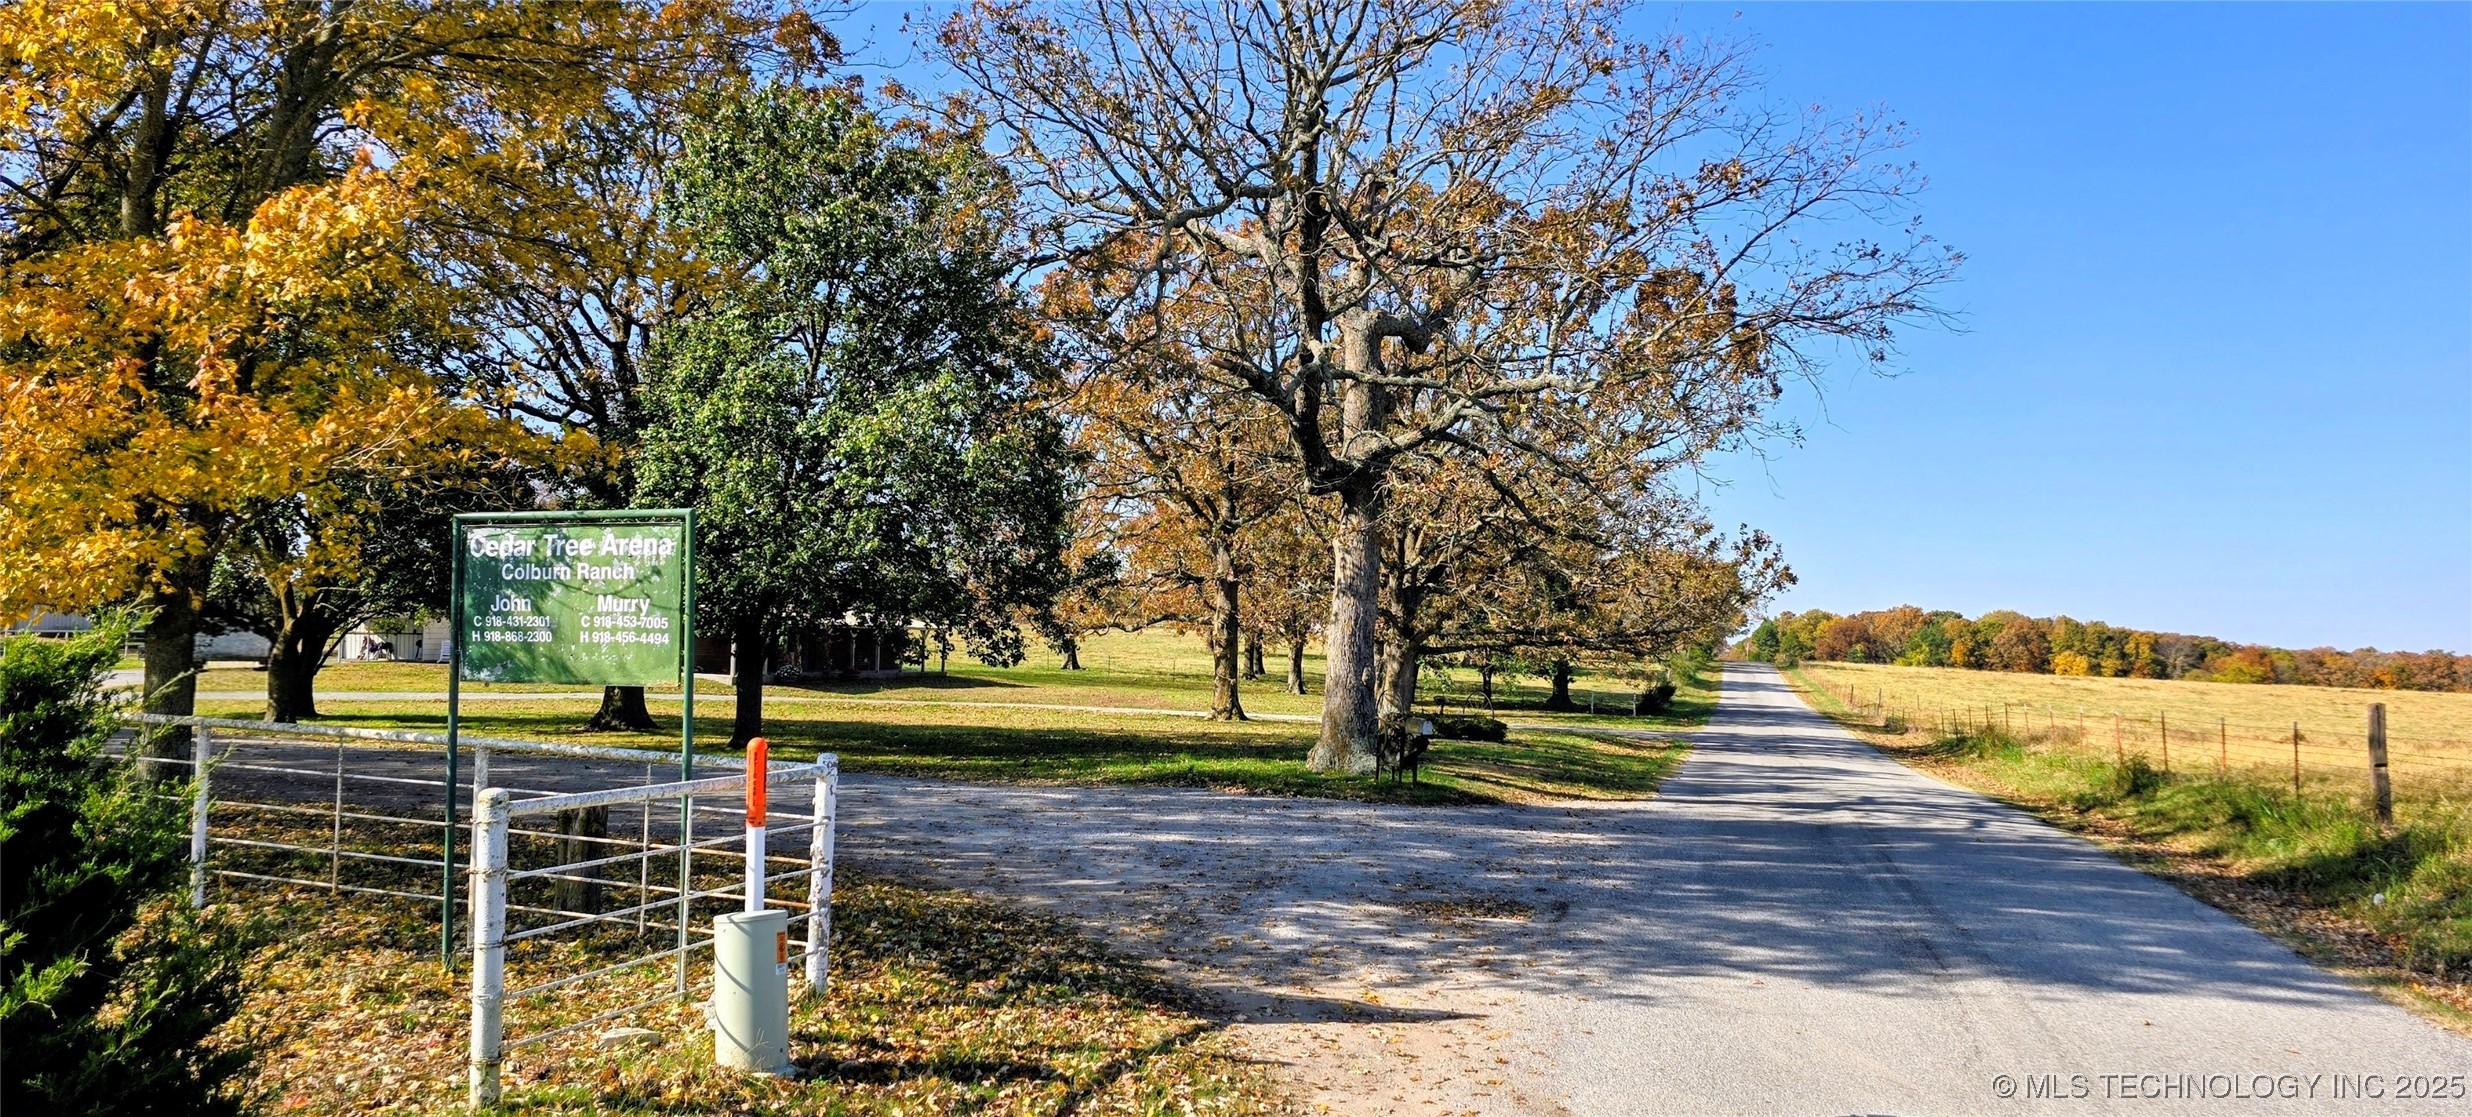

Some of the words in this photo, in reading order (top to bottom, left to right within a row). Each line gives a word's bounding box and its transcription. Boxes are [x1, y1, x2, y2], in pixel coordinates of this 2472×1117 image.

[470, 534, 536, 558] Cedar
[543, 534, 593, 557] Tree
[601, 533, 672, 557] Arena
[501, 563, 571, 580] Colburn
[577, 563, 635, 580] Ranch
[490, 594, 532, 612] John
[597, 595, 651, 616] Murry
[473, 616, 482, 627] C
[485, 616, 550, 628] 918-431-2301
[581, 616, 590, 628] C
[593, 617, 669, 629] 918-453-7005
[472, 631, 481, 642] H
[484, 631, 552, 643] 918-868-2300
[580, 632, 589, 643] H
[592, 632, 670, 644] 918-456-4494
